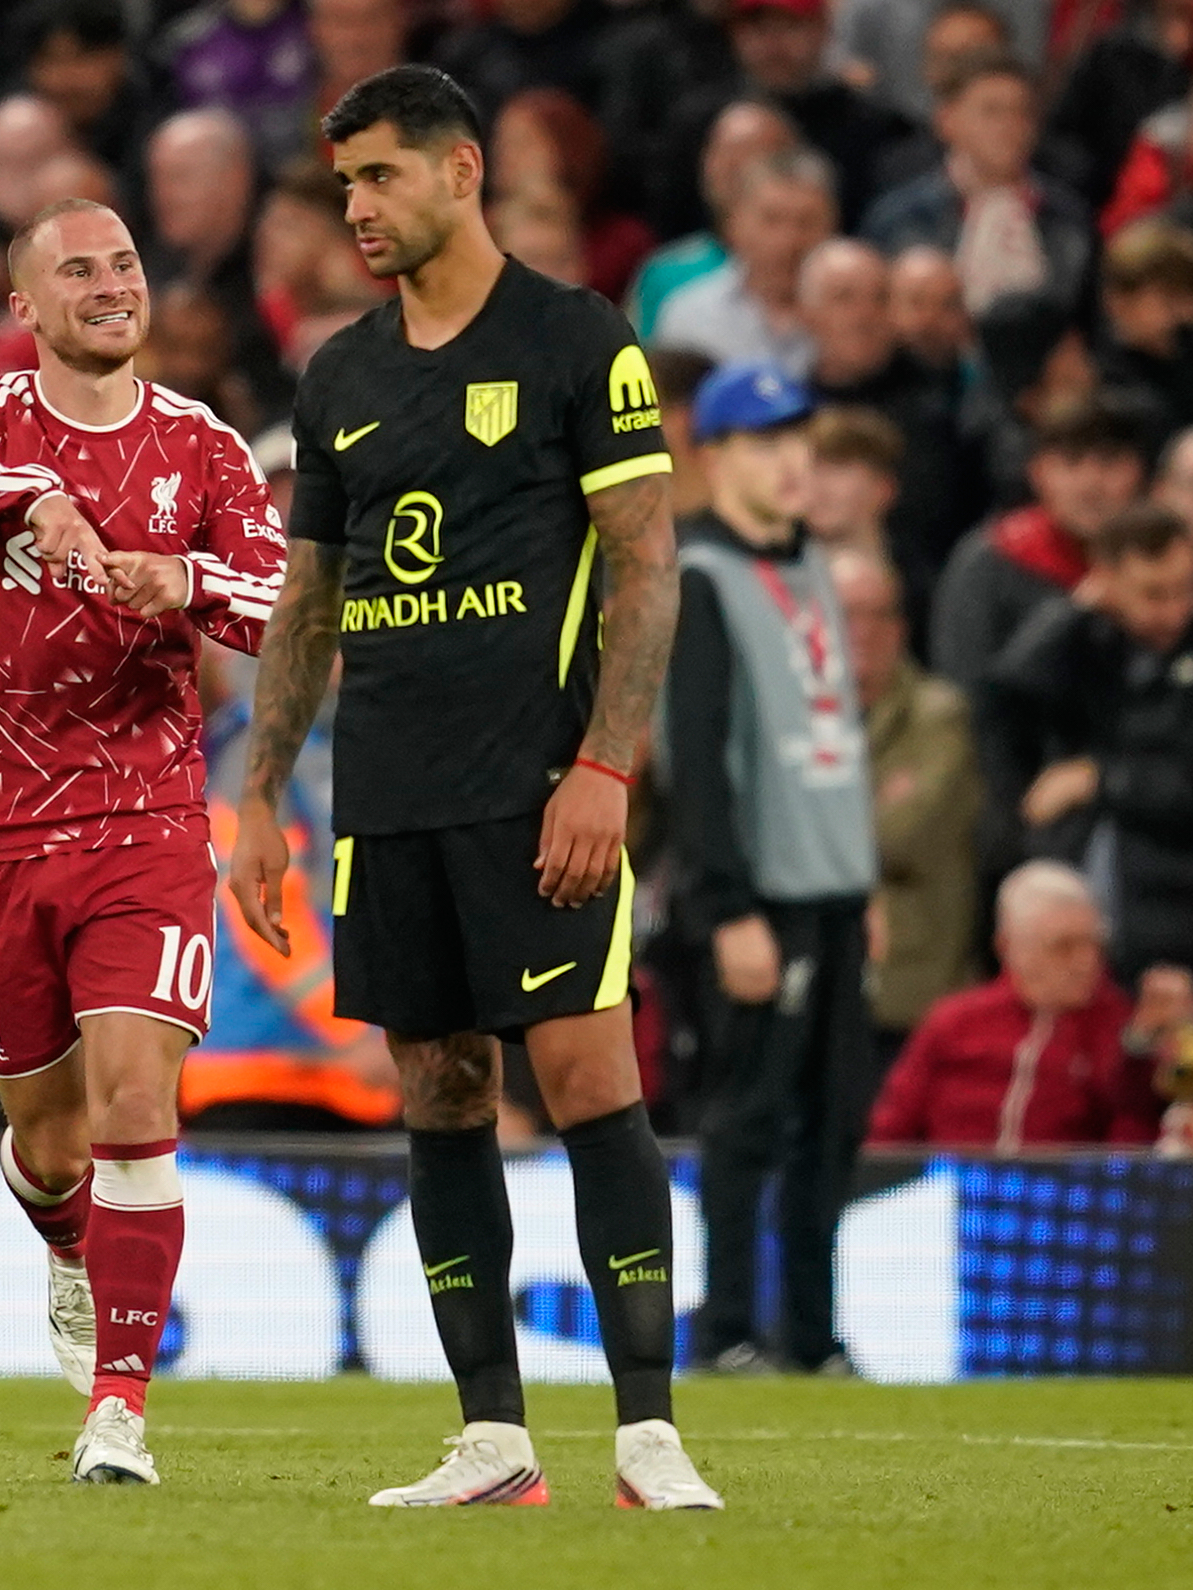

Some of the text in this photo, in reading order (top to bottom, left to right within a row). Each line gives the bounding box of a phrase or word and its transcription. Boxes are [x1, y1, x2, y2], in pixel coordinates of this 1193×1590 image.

[340, 580, 527, 633] RIYADH AIR
[150, 925, 212, 1011] 10
[110, 1307, 158, 1326] LFC
